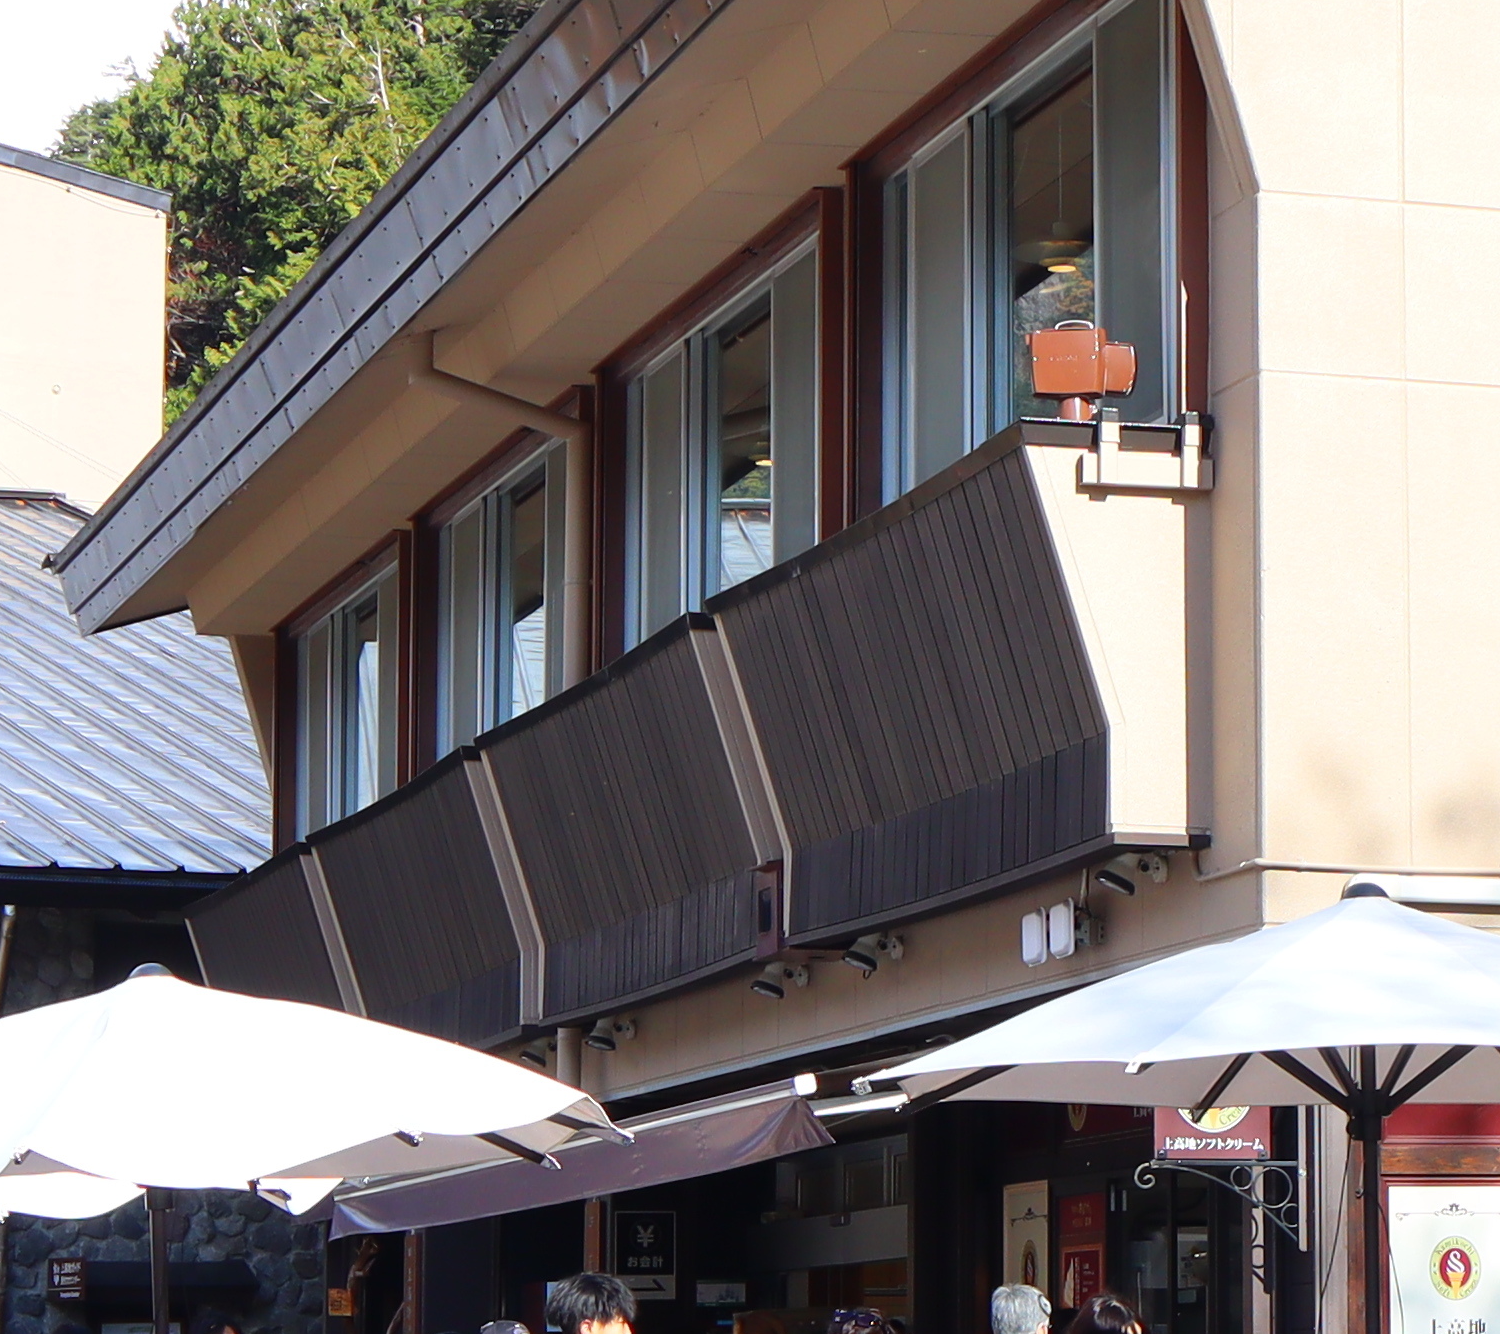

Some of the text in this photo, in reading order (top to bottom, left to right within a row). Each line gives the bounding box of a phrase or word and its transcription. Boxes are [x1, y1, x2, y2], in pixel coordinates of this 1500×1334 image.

[1162, 1136, 1265, 1151] 上高地ソフトクリーム
[626, 1255, 664, 1268] お会計
